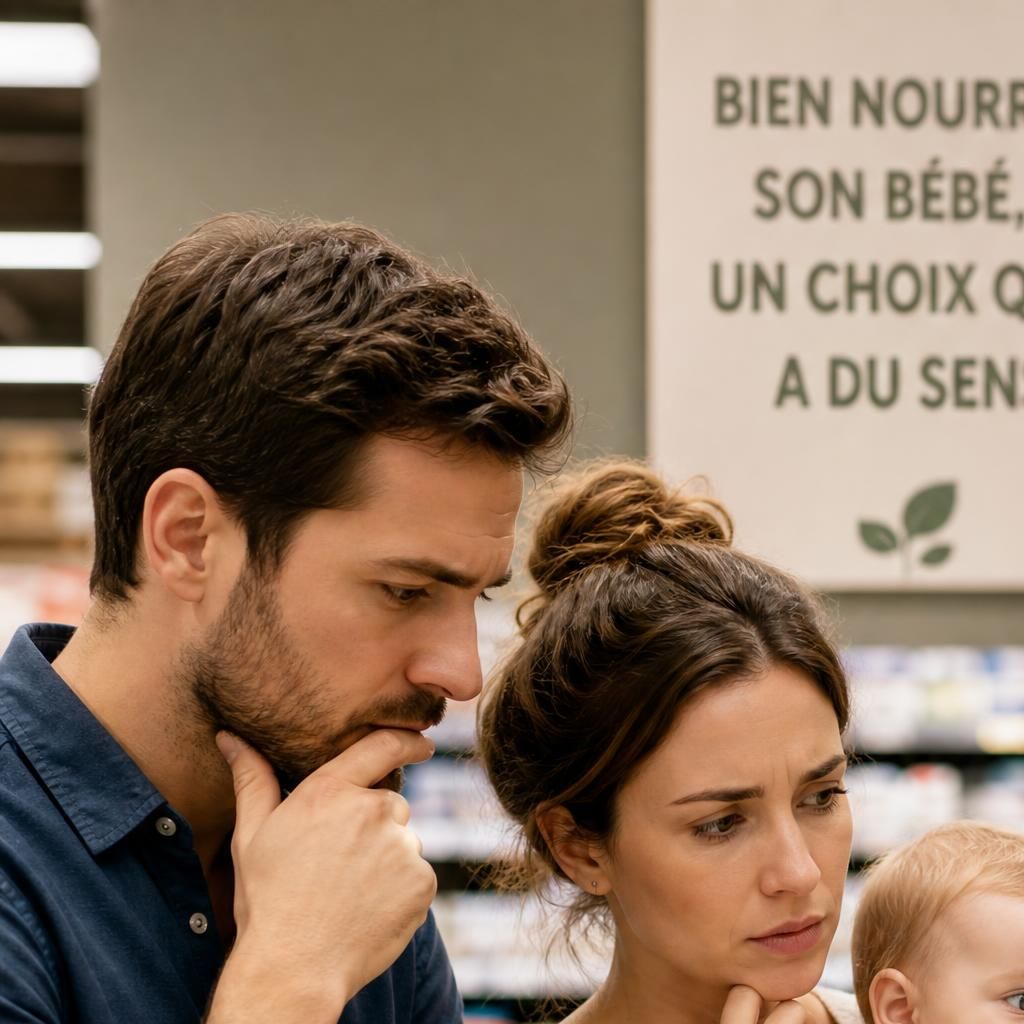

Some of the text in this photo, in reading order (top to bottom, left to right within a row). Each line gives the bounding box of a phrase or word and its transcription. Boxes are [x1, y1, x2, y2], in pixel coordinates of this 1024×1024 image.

[715, 76, 831, 127] BIEN
[754, 168, 864, 220] SON
[711, 263, 786, 313] UN
[807, 262, 976, 315] CHOIX
[774, 356, 809, 407] A
[828, 357, 900, 409] DU
